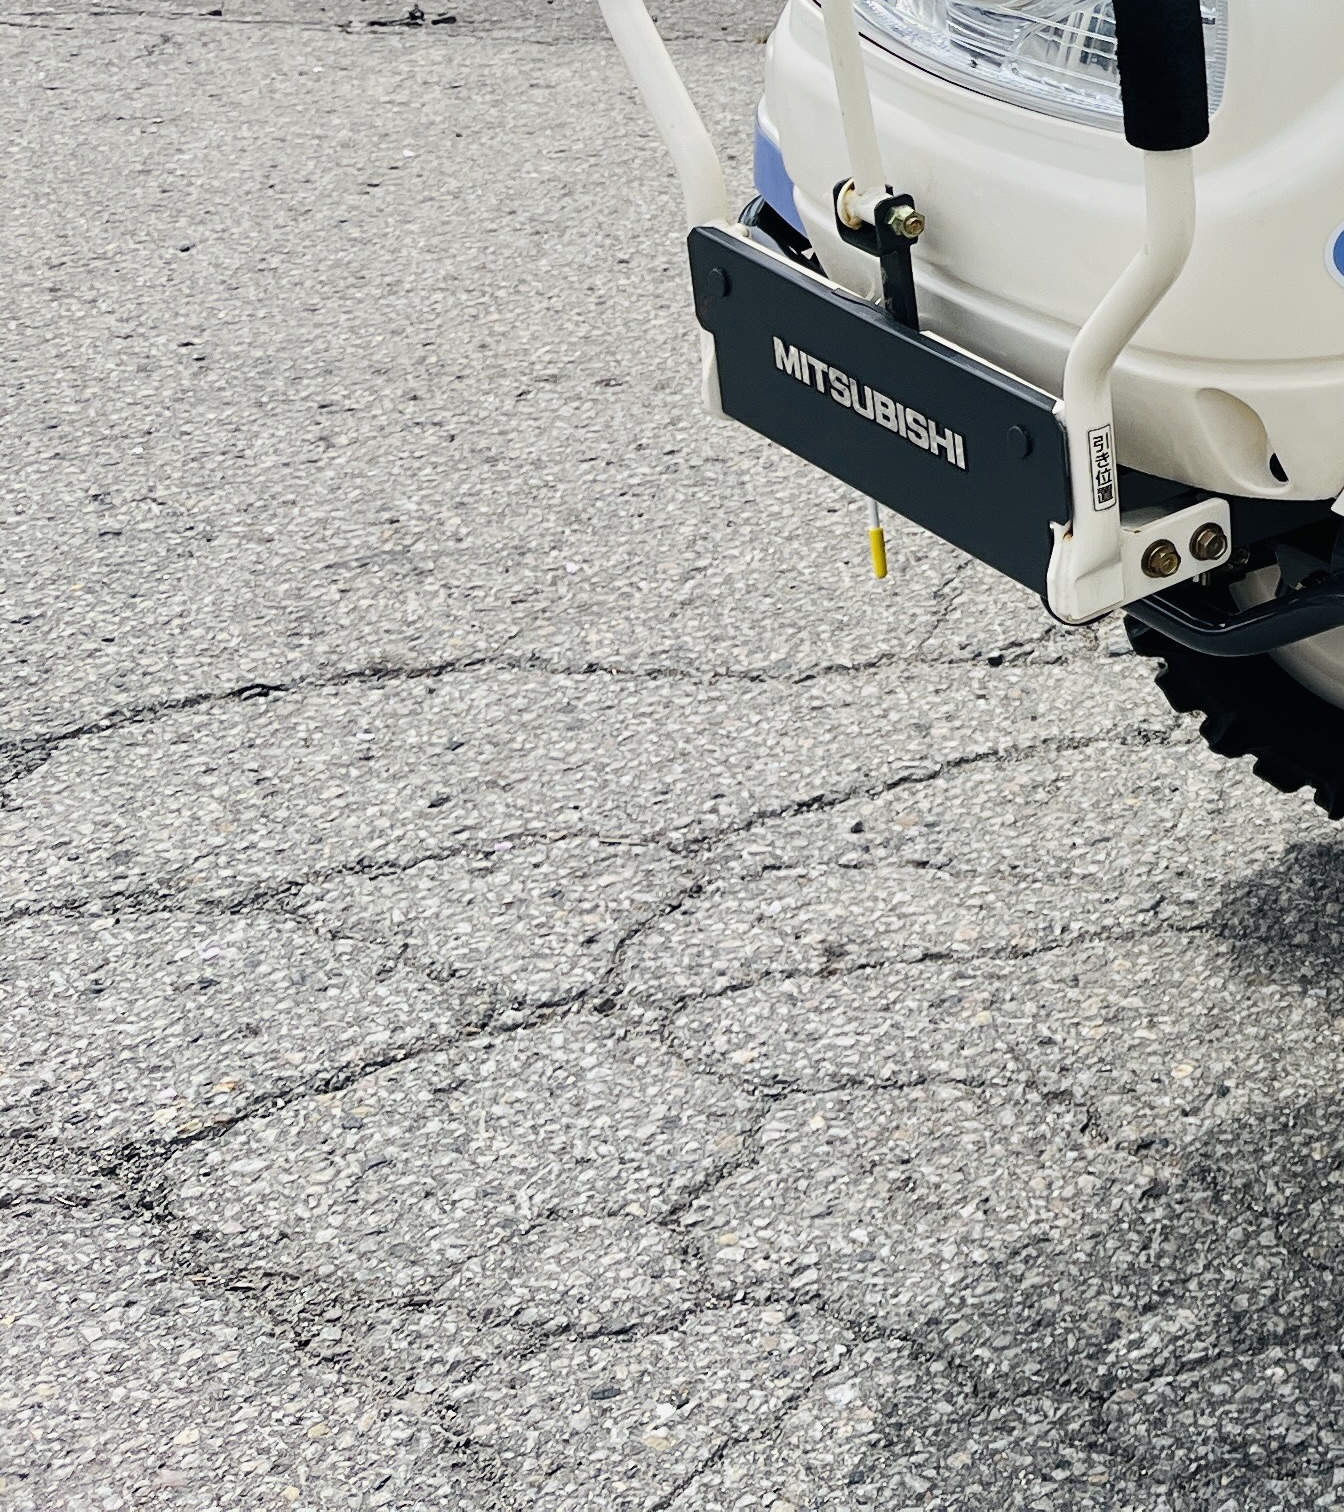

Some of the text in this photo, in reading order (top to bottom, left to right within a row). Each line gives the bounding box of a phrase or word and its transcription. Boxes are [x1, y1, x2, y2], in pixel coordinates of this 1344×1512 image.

[773, 336, 967, 470] MITSUBISHI
[1093, 432, 1114, 505] 引き位置
